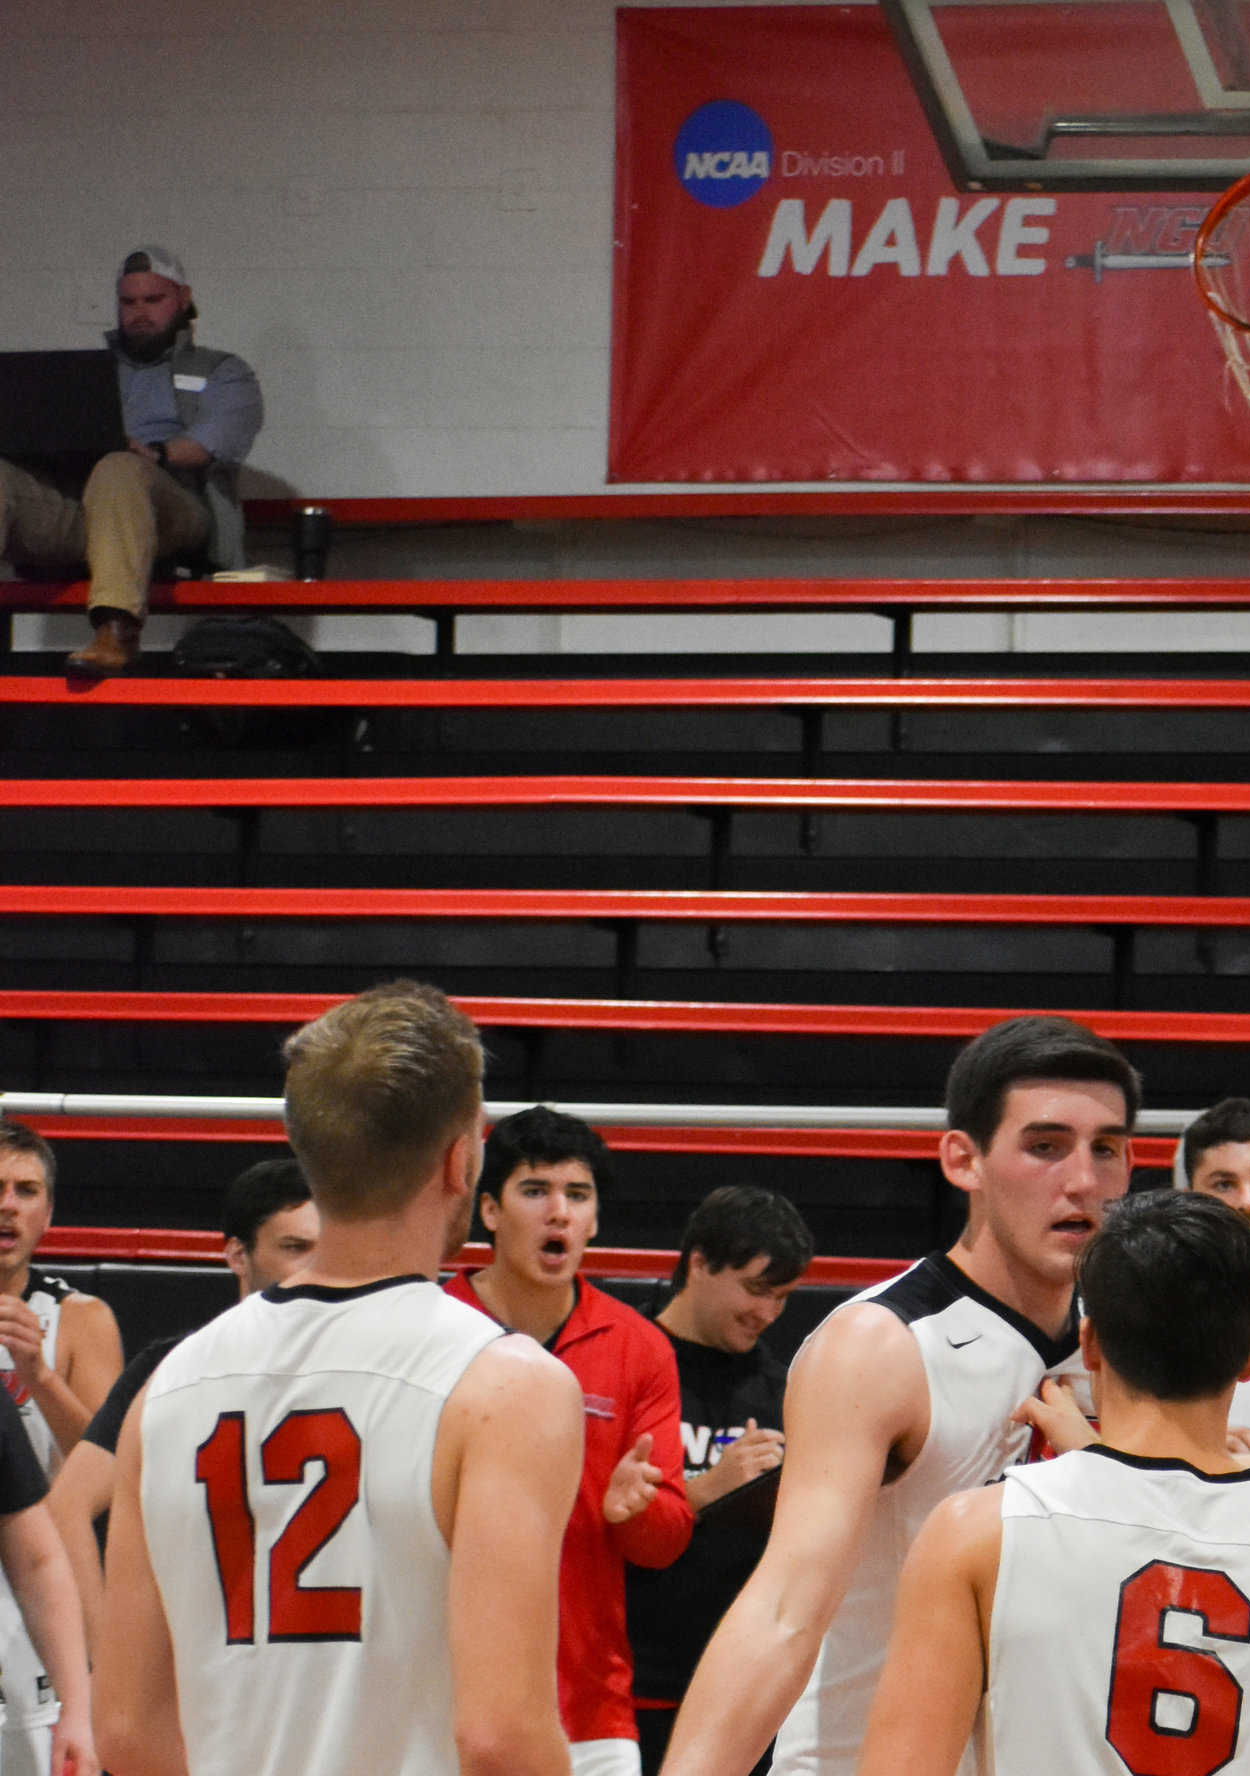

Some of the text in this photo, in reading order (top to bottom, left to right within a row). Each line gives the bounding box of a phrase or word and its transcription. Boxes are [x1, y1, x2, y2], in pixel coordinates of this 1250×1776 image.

[684, 150, 905, 179] NCAA Division II
[757, 197, 1056, 278] MAKE
[195, 1406, 363, 1645] 12
